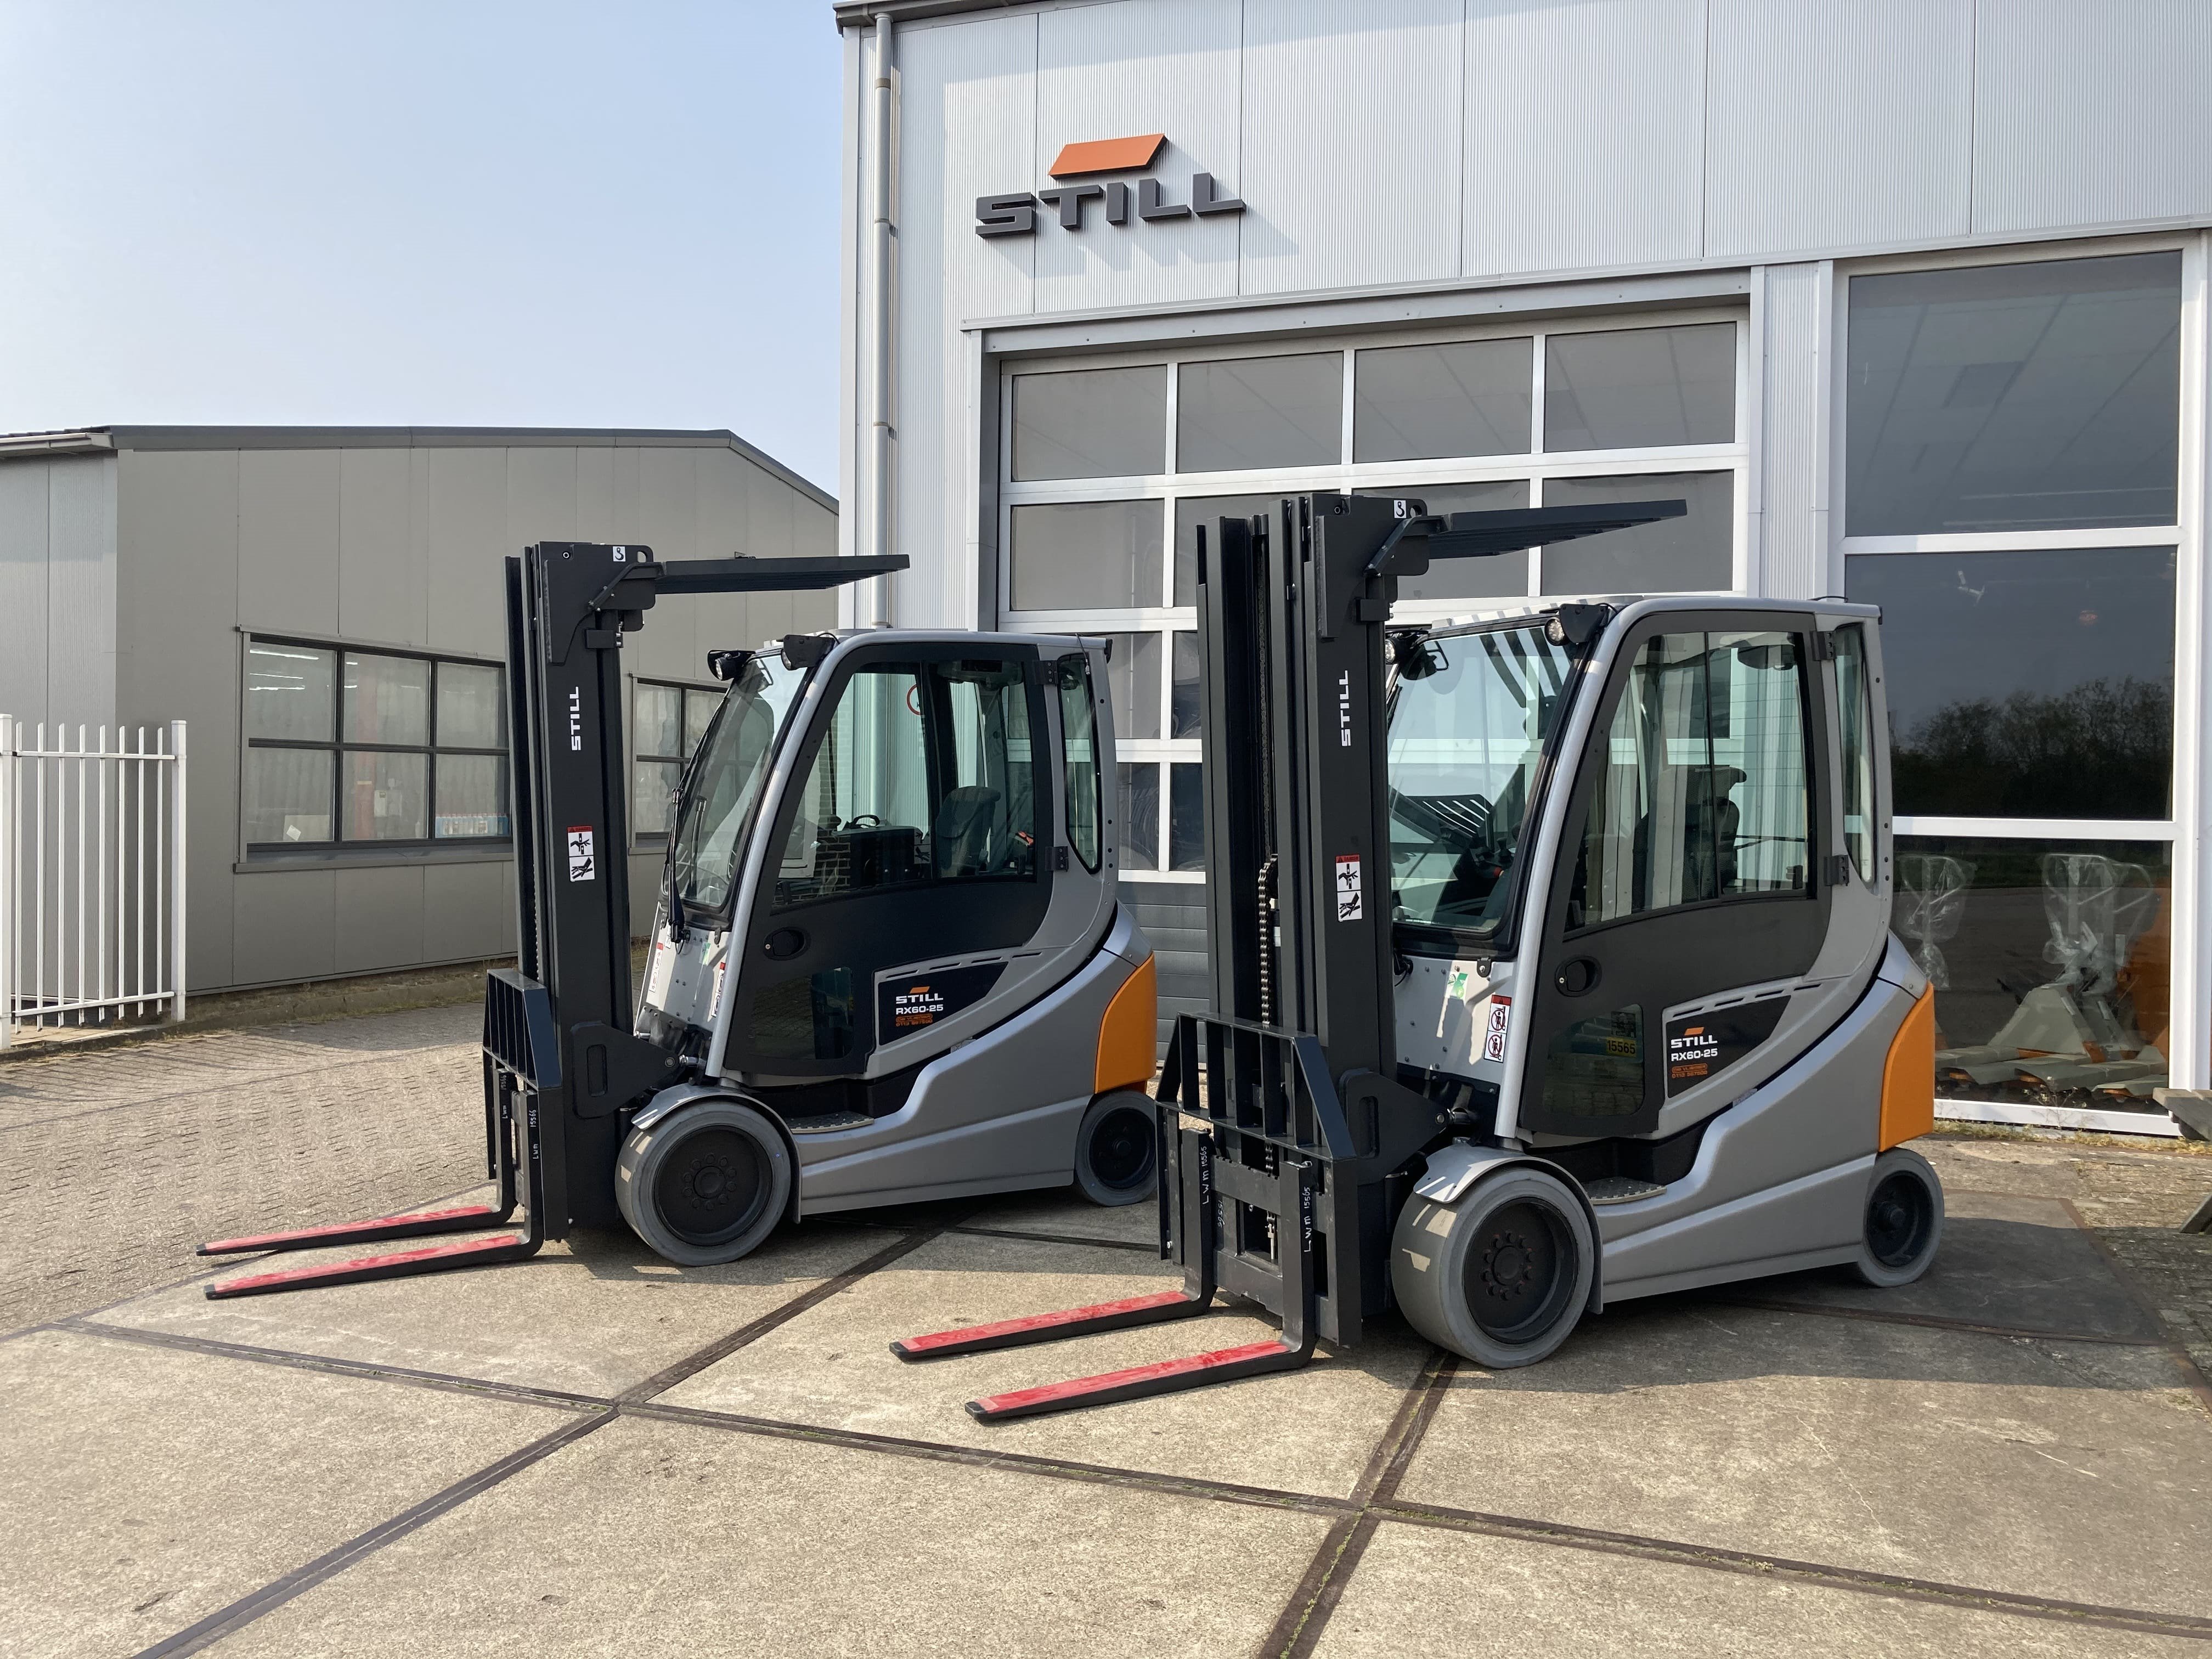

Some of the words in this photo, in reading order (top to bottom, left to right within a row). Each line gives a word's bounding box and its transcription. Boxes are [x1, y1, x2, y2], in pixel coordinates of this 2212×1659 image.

[975, 172, 1246, 239] STILL
[569, 686, 582, 751] STILL
[1339, 670, 1351, 747] STILL
[895, 992, 944, 1005] STILL
[895, 1004, 944, 1015] RX60-25
[1607, 1040, 1635, 1054] 15565
[1671, 1035, 1718, 1048] STILL
[1671, 1048, 1718, 1062] RX60-25
[1200, 1146, 1208, 1167] 15565
[1302, 1187, 1311, 1209] 15565
[1216, 1200, 1225, 1228] 15565
